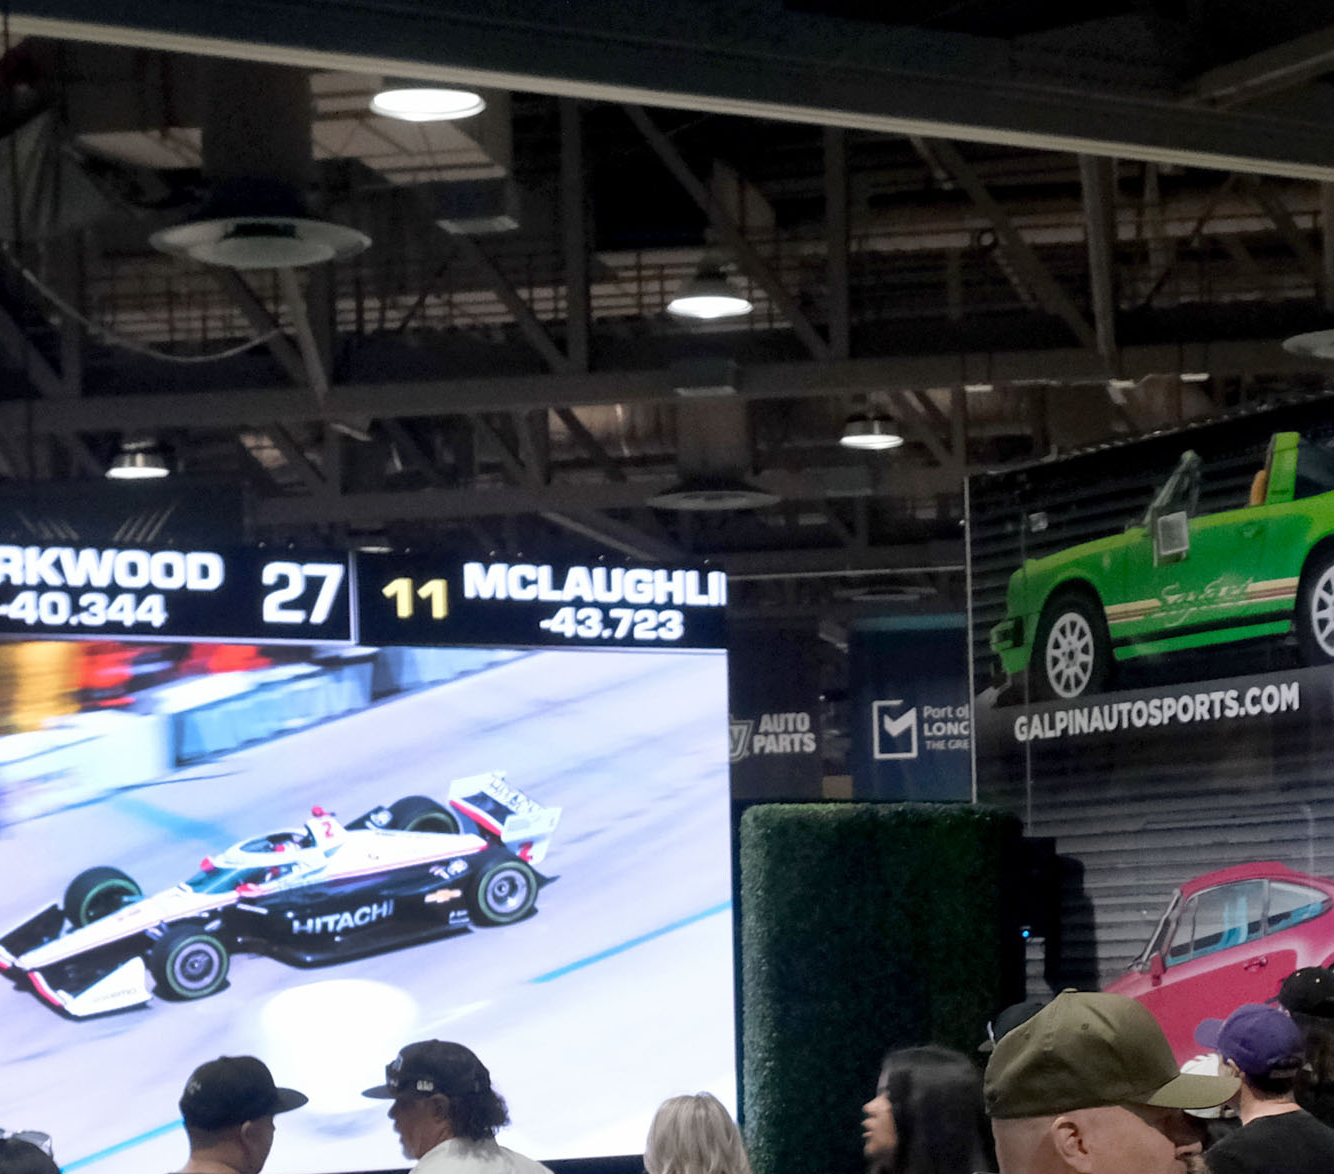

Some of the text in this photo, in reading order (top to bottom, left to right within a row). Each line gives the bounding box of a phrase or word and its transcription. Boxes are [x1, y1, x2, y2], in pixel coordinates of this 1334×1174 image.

[261, 561, 346, 625] 27
[381, 561, 728, 620] 11 MCLAUGHLI
[539, 606, 685, 641] -43.723
[758, 711, 811, 734] AUTO
[1013, 680, 1301, 743] GALPINAUTOSPORTS.COM
[752, 732, 817, 755] PARTS
[292, 899, 396, 935] HITACHI
